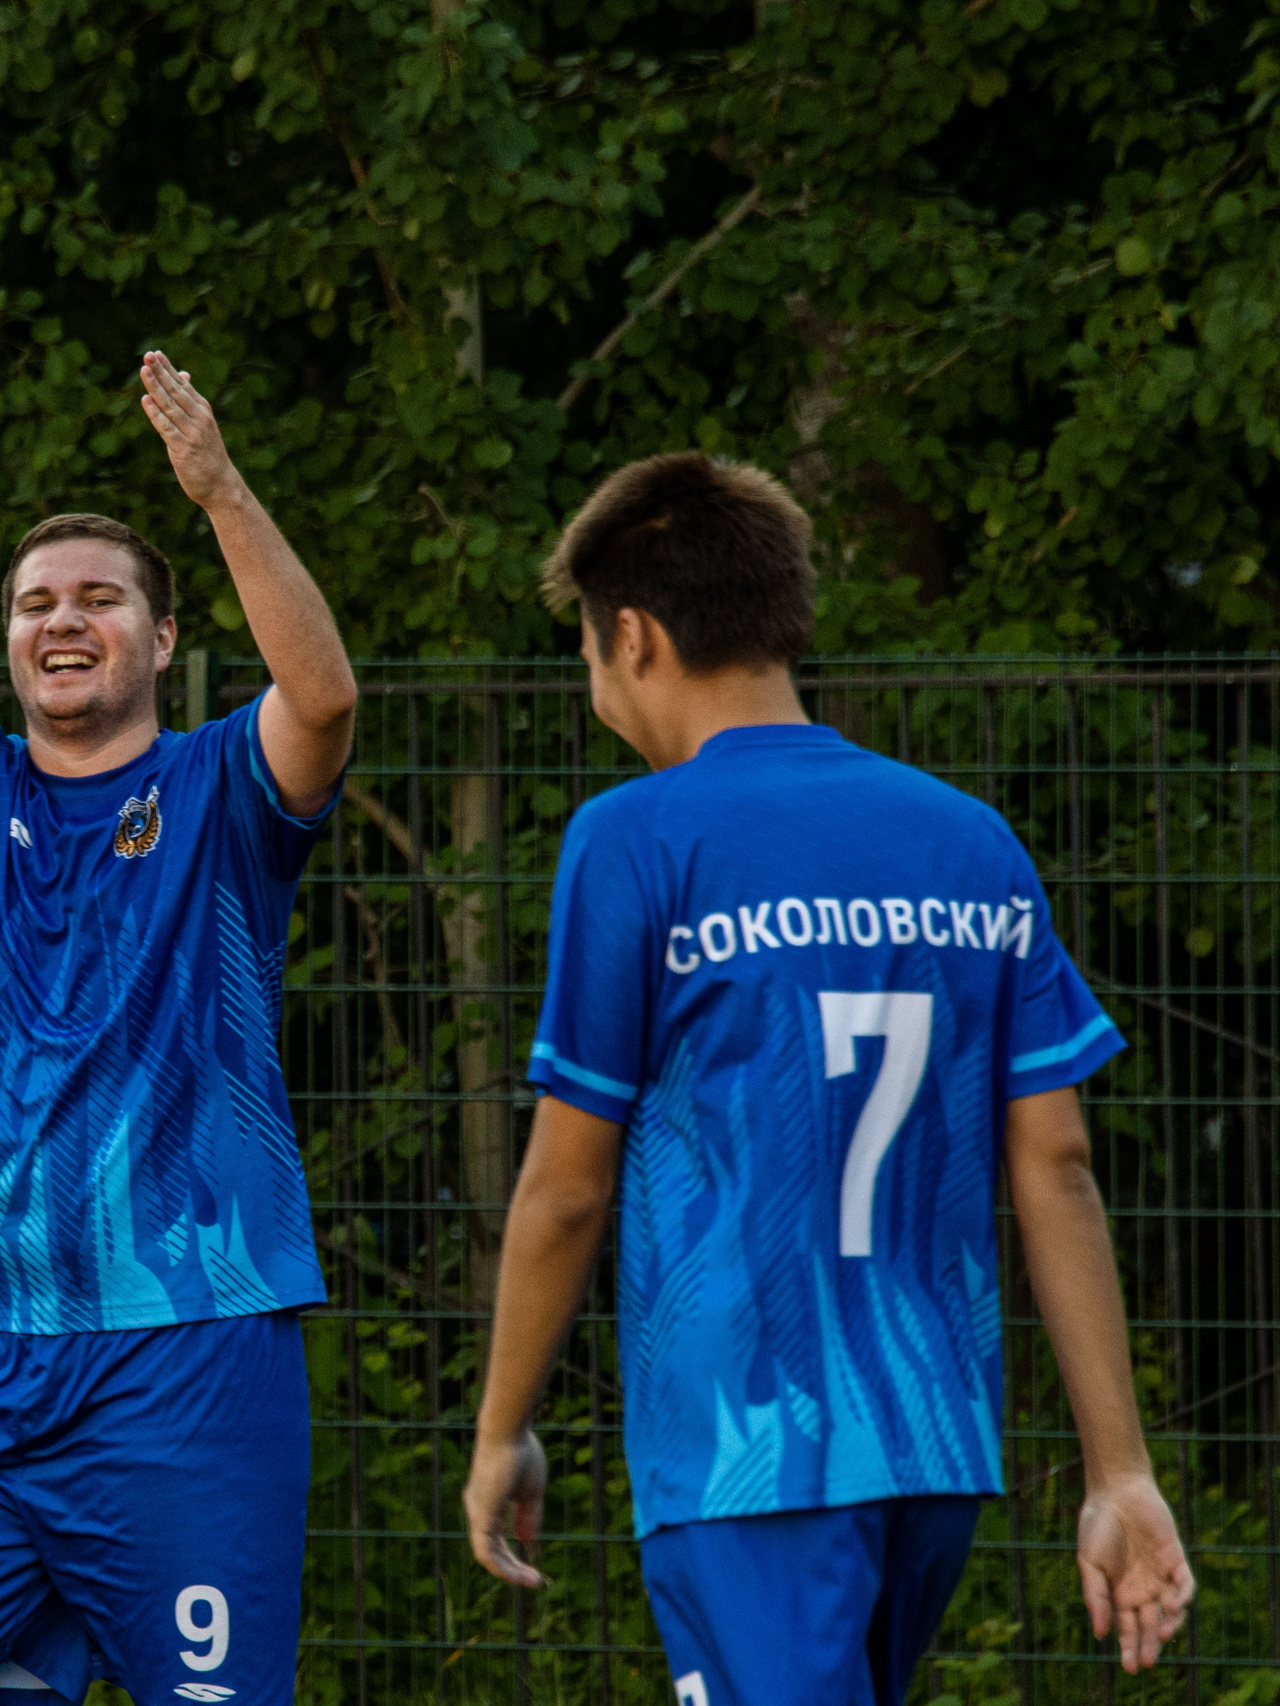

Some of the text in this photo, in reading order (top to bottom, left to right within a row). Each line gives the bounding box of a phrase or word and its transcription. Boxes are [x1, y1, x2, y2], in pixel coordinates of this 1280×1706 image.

[665, 896, 1033, 975] СОКОЛОВСКИЙ
[817, 991, 934, 1257] 7
[175, 1584, 230, 1672] 9
